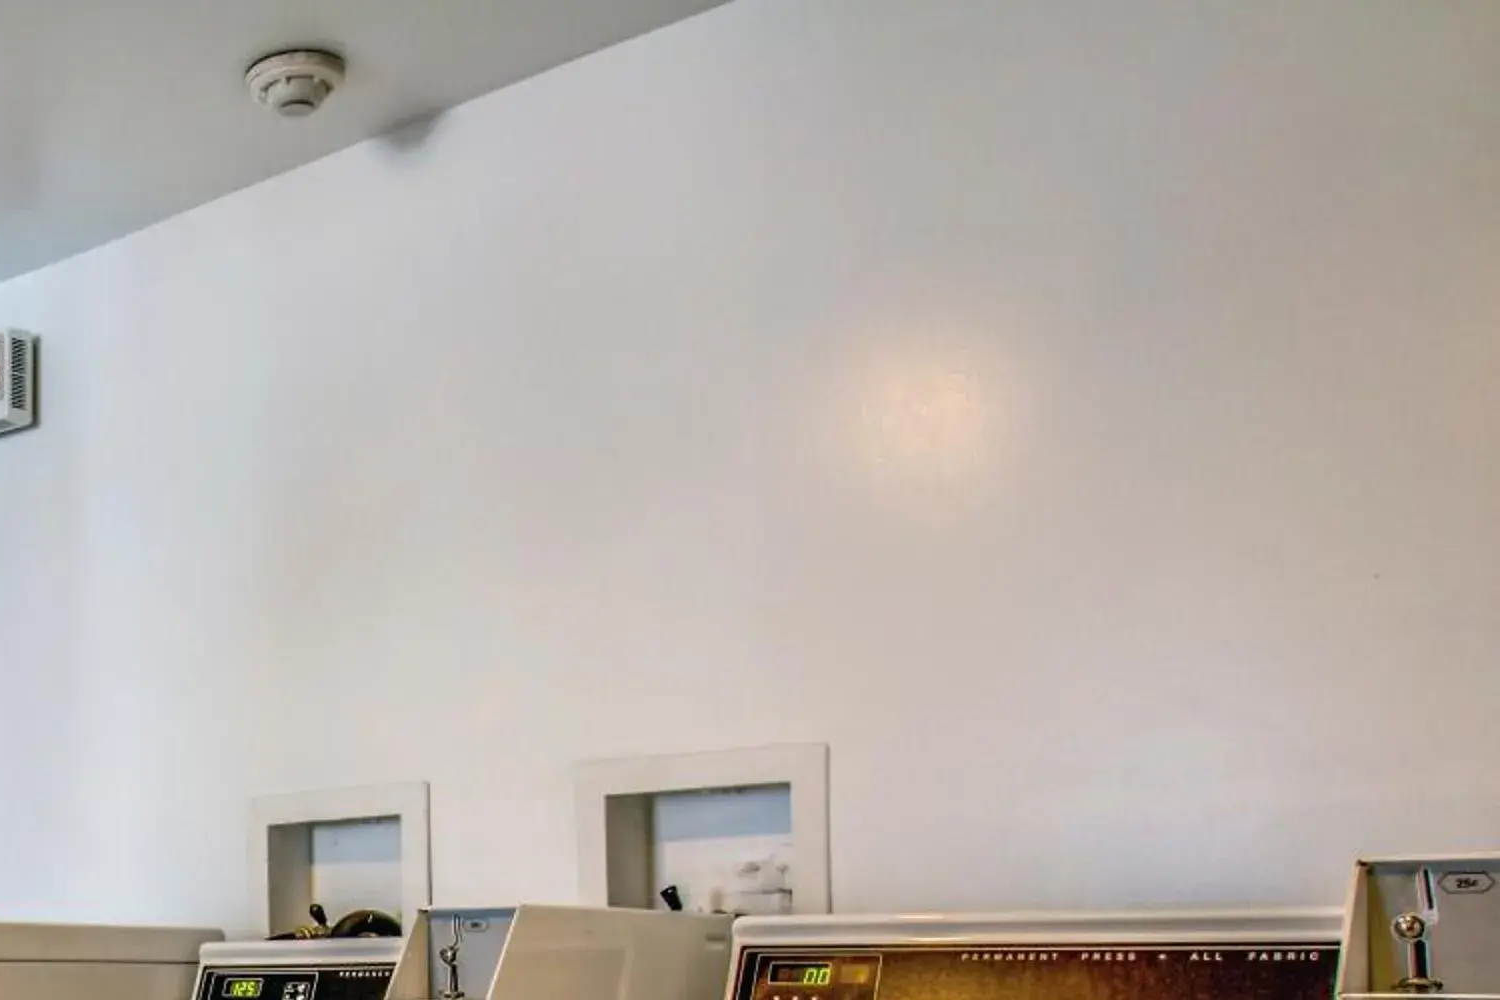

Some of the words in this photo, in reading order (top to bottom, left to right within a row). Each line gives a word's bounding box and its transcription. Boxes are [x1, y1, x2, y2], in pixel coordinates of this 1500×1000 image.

[961, 952, 1059, 961] PERMANENT
[1081, 952, 1137, 962] PRESS
[1190, 952, 1224, 962] ALL
[1247, 952, 1321, 962] FABRIC
